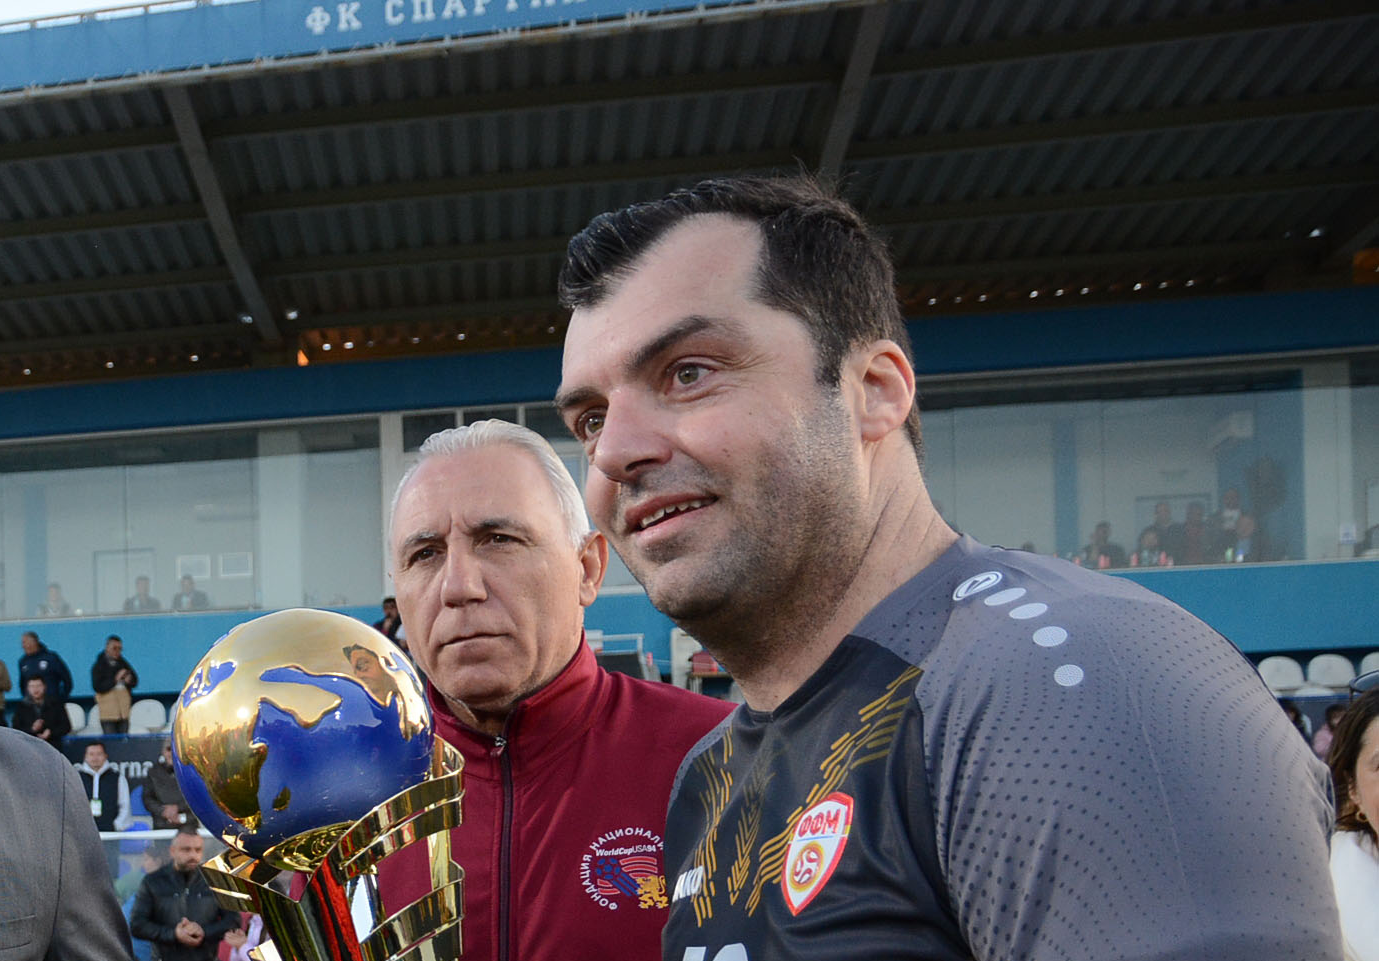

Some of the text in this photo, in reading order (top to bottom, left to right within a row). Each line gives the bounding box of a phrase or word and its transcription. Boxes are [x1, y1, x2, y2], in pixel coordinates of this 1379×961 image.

[305, 0, 587, 35] ФК СПАР
[579, 853, 619, 911] ФОНДАЦИЯ
